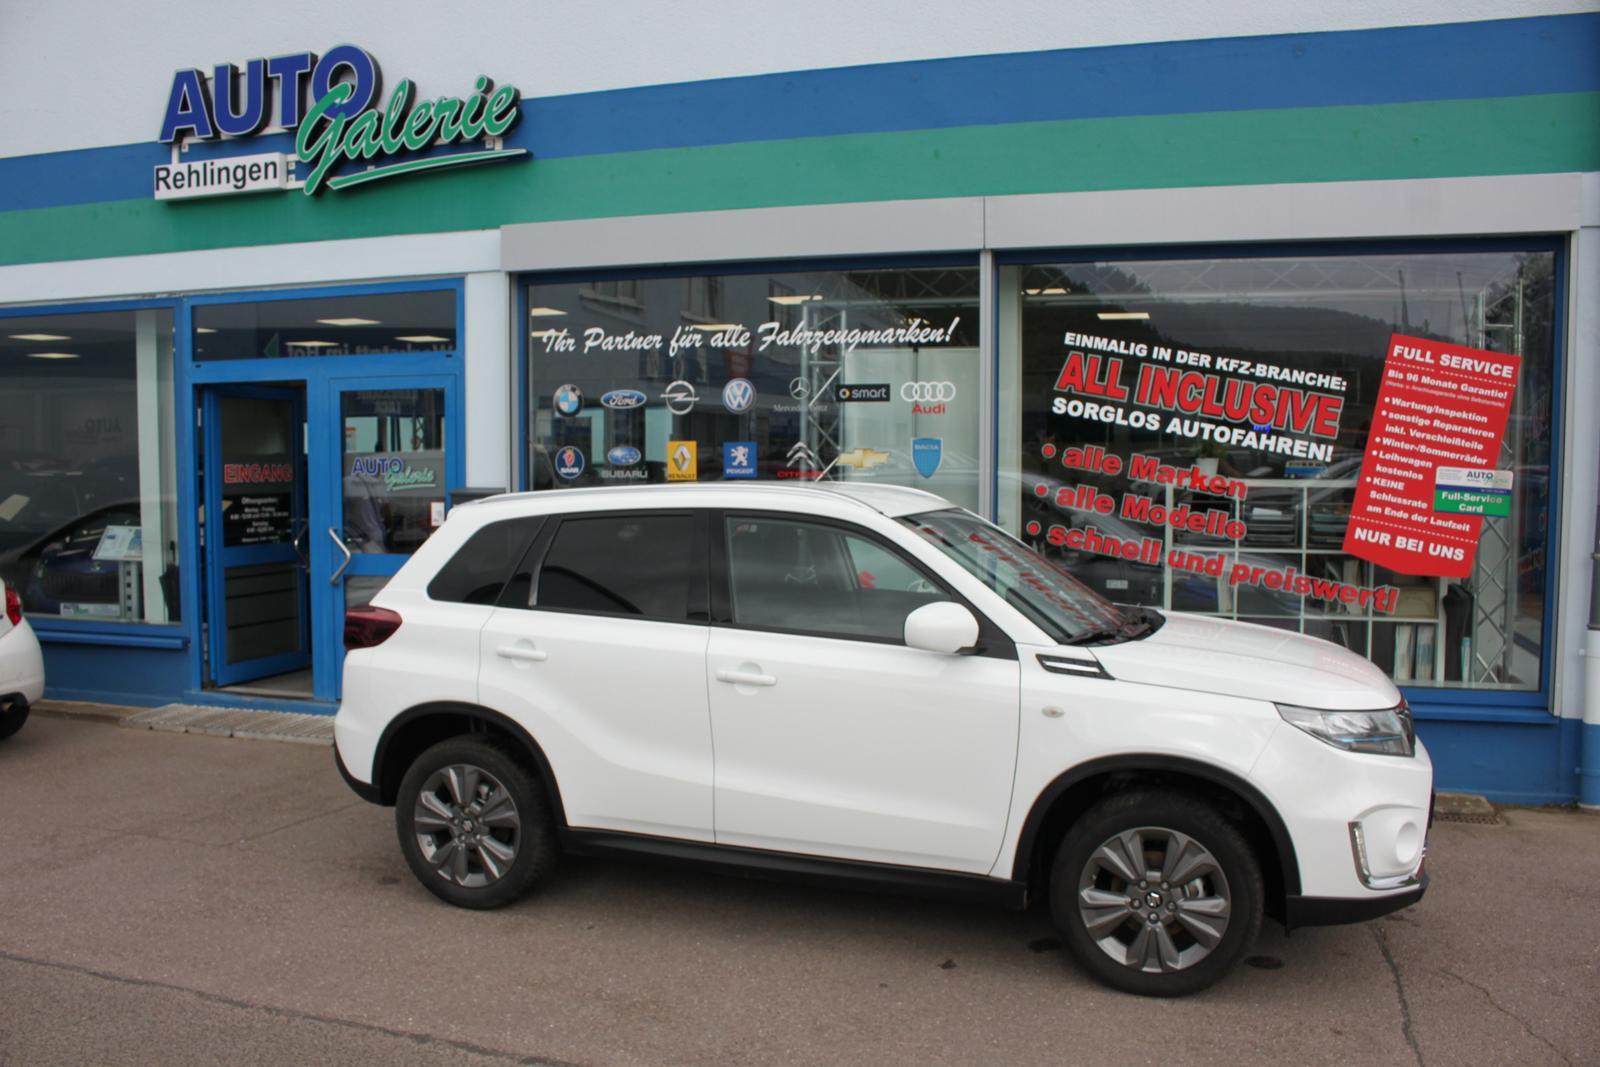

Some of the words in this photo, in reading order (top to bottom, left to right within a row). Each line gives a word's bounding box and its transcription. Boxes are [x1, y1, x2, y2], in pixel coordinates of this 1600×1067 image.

[158, 43, 376, 143] AUTO
[296, 75, 517, 195] Galerie
[155, 160, 277, 191] Rehlingen
[542, 328, 576, 352] Ihr
[583, 326, 663, 354] Partner
[668, 325, 703, 357] für
[709, 324, 750, 347] alle
[757, 317, 960, 354] Fahrzeugmarken!
[1064, 332, 1148, 357] EINMALIG
[1152, 346, 1171, 361] IN
[1176, 350, 1212, 369] DER
[1216, 356, 1347, 391] KFZ-BRANCHE:
[1392, 345, 1435, 364] FULL
[1440, 354, 1514, 378] SERVICE
[851, 387, 887, 399] smart
[1055, 350, 1129, 402] ALL
[1133, 362, 1345, 439] INCLUSIVE
[1387, 369, 1404, 380] Bis
[1421, 376, 1458, 390] Monate
[1461, 383, 1508, 400] Garantie!
[608, 395, 638, 406] Ford
[911, 403, 946, 414] Audi
[1391, 397, 1488, 423] Wartung/Inspektion
[1051, 397, 1161, 431] SORGLOS
[1165, 417, 1335, 462] AUTOFAHREN!
[1385, 424, 1407, 435] inkl.
[1408, 427, 1484, 450] Verschleißteile
[1388, 411, 1431, 426] sonstige
[1432, 418, 1495, 439] Reparaturen
[352, 457, 403, 476] AUTO
[1062, 444, 1123, 475] alle
[1127, 452, 1248, 500] Marken
[1376, 464, 1424, 480] kostenlos
[1378, 450, 1433, 468] Leihwagen
[224, 463, 293, 484] EINGANG
[601, 470, 648, 478] SUBARU
[1372, 477, 1406, 491] KEINE
[1466, 471, 1494, 481] AUTO
[1369, 490, 1428, 510] Schlussrate
[1441, 491, 1503, 504] Full-Service
[1458, 503, 1484, 513] Card
[1055, 484, 1116, 516] alle
[1120, 492, 1247, 540] Modelle
[1366, 504, 1382, 514] am
[1384, 507, 1409, 520] Ende
[1411, 511, 1428, 523] der
[1430, 516, 1471, 533] Laufzeit
[1046, 524, 1163, 566] schnell
[1166, 549, 1226, 578] und
[1354, 527, 1392, 546] NUR
[1394, 536, 1424, 553] BEI
[1428, 543, 1465, 561] UNS
